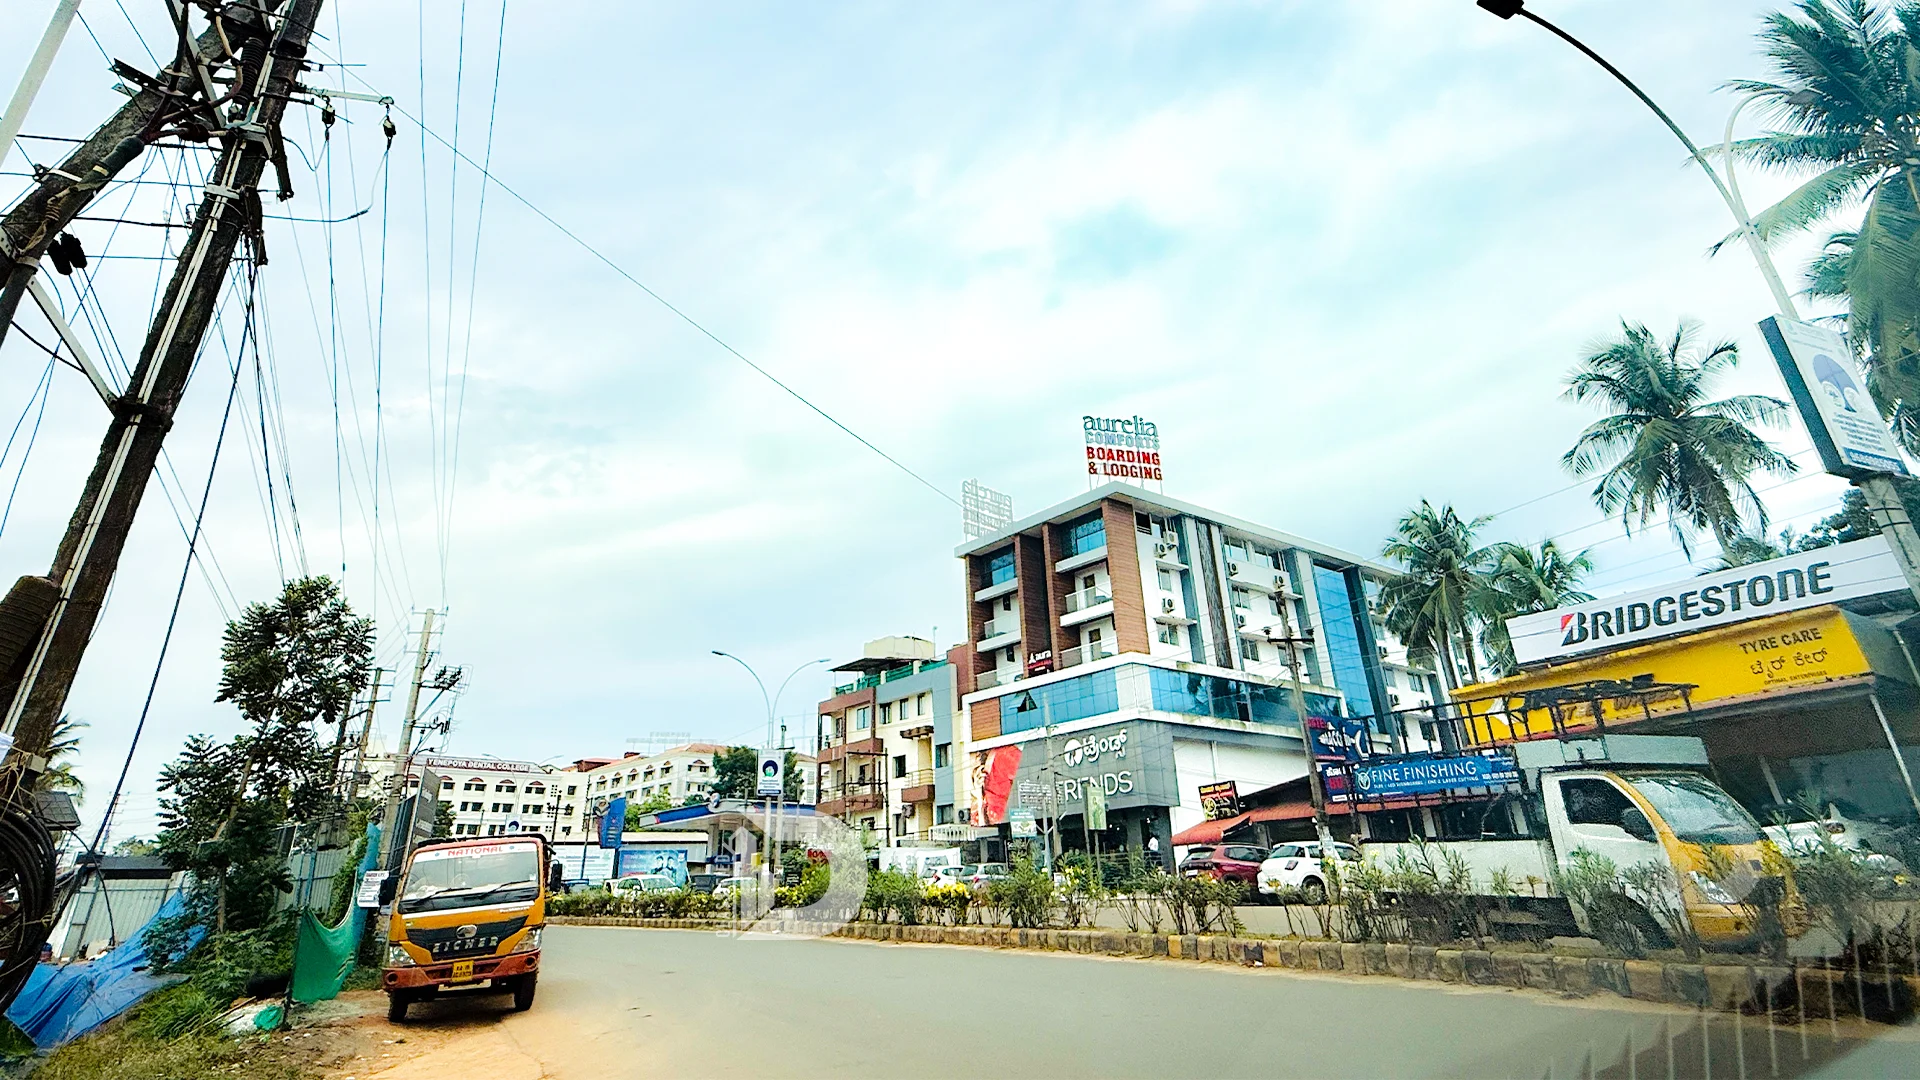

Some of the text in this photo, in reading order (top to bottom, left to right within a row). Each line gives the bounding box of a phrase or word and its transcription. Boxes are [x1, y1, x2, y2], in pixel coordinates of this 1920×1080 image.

[1082, 415, 1159, 438] aurelia
[1085, 431, 1160, 450] COMFORTS
[1086, 446, 1161, 465] BOARDING
[1088, 462, 1163, 481] & LODGING
[1561, 561, 1834, 647] BRIDGESTONE
[1739, 627, 1822, 655] TYRE CARE
[1750, 655, 1787, 679] ಟೈರ್
[1789, 670, 1828, 681] ENTERPRISES
[428, 758, 529, 772] YENEPOYA DENTAL COLLEGE
[1372, 768, 1400, 783] FINE
[1404, 761, 1477, 781] FINISHING
[447, 846, 504, 857] NATIONAL
[432, 936, 499, 953] EICHER
